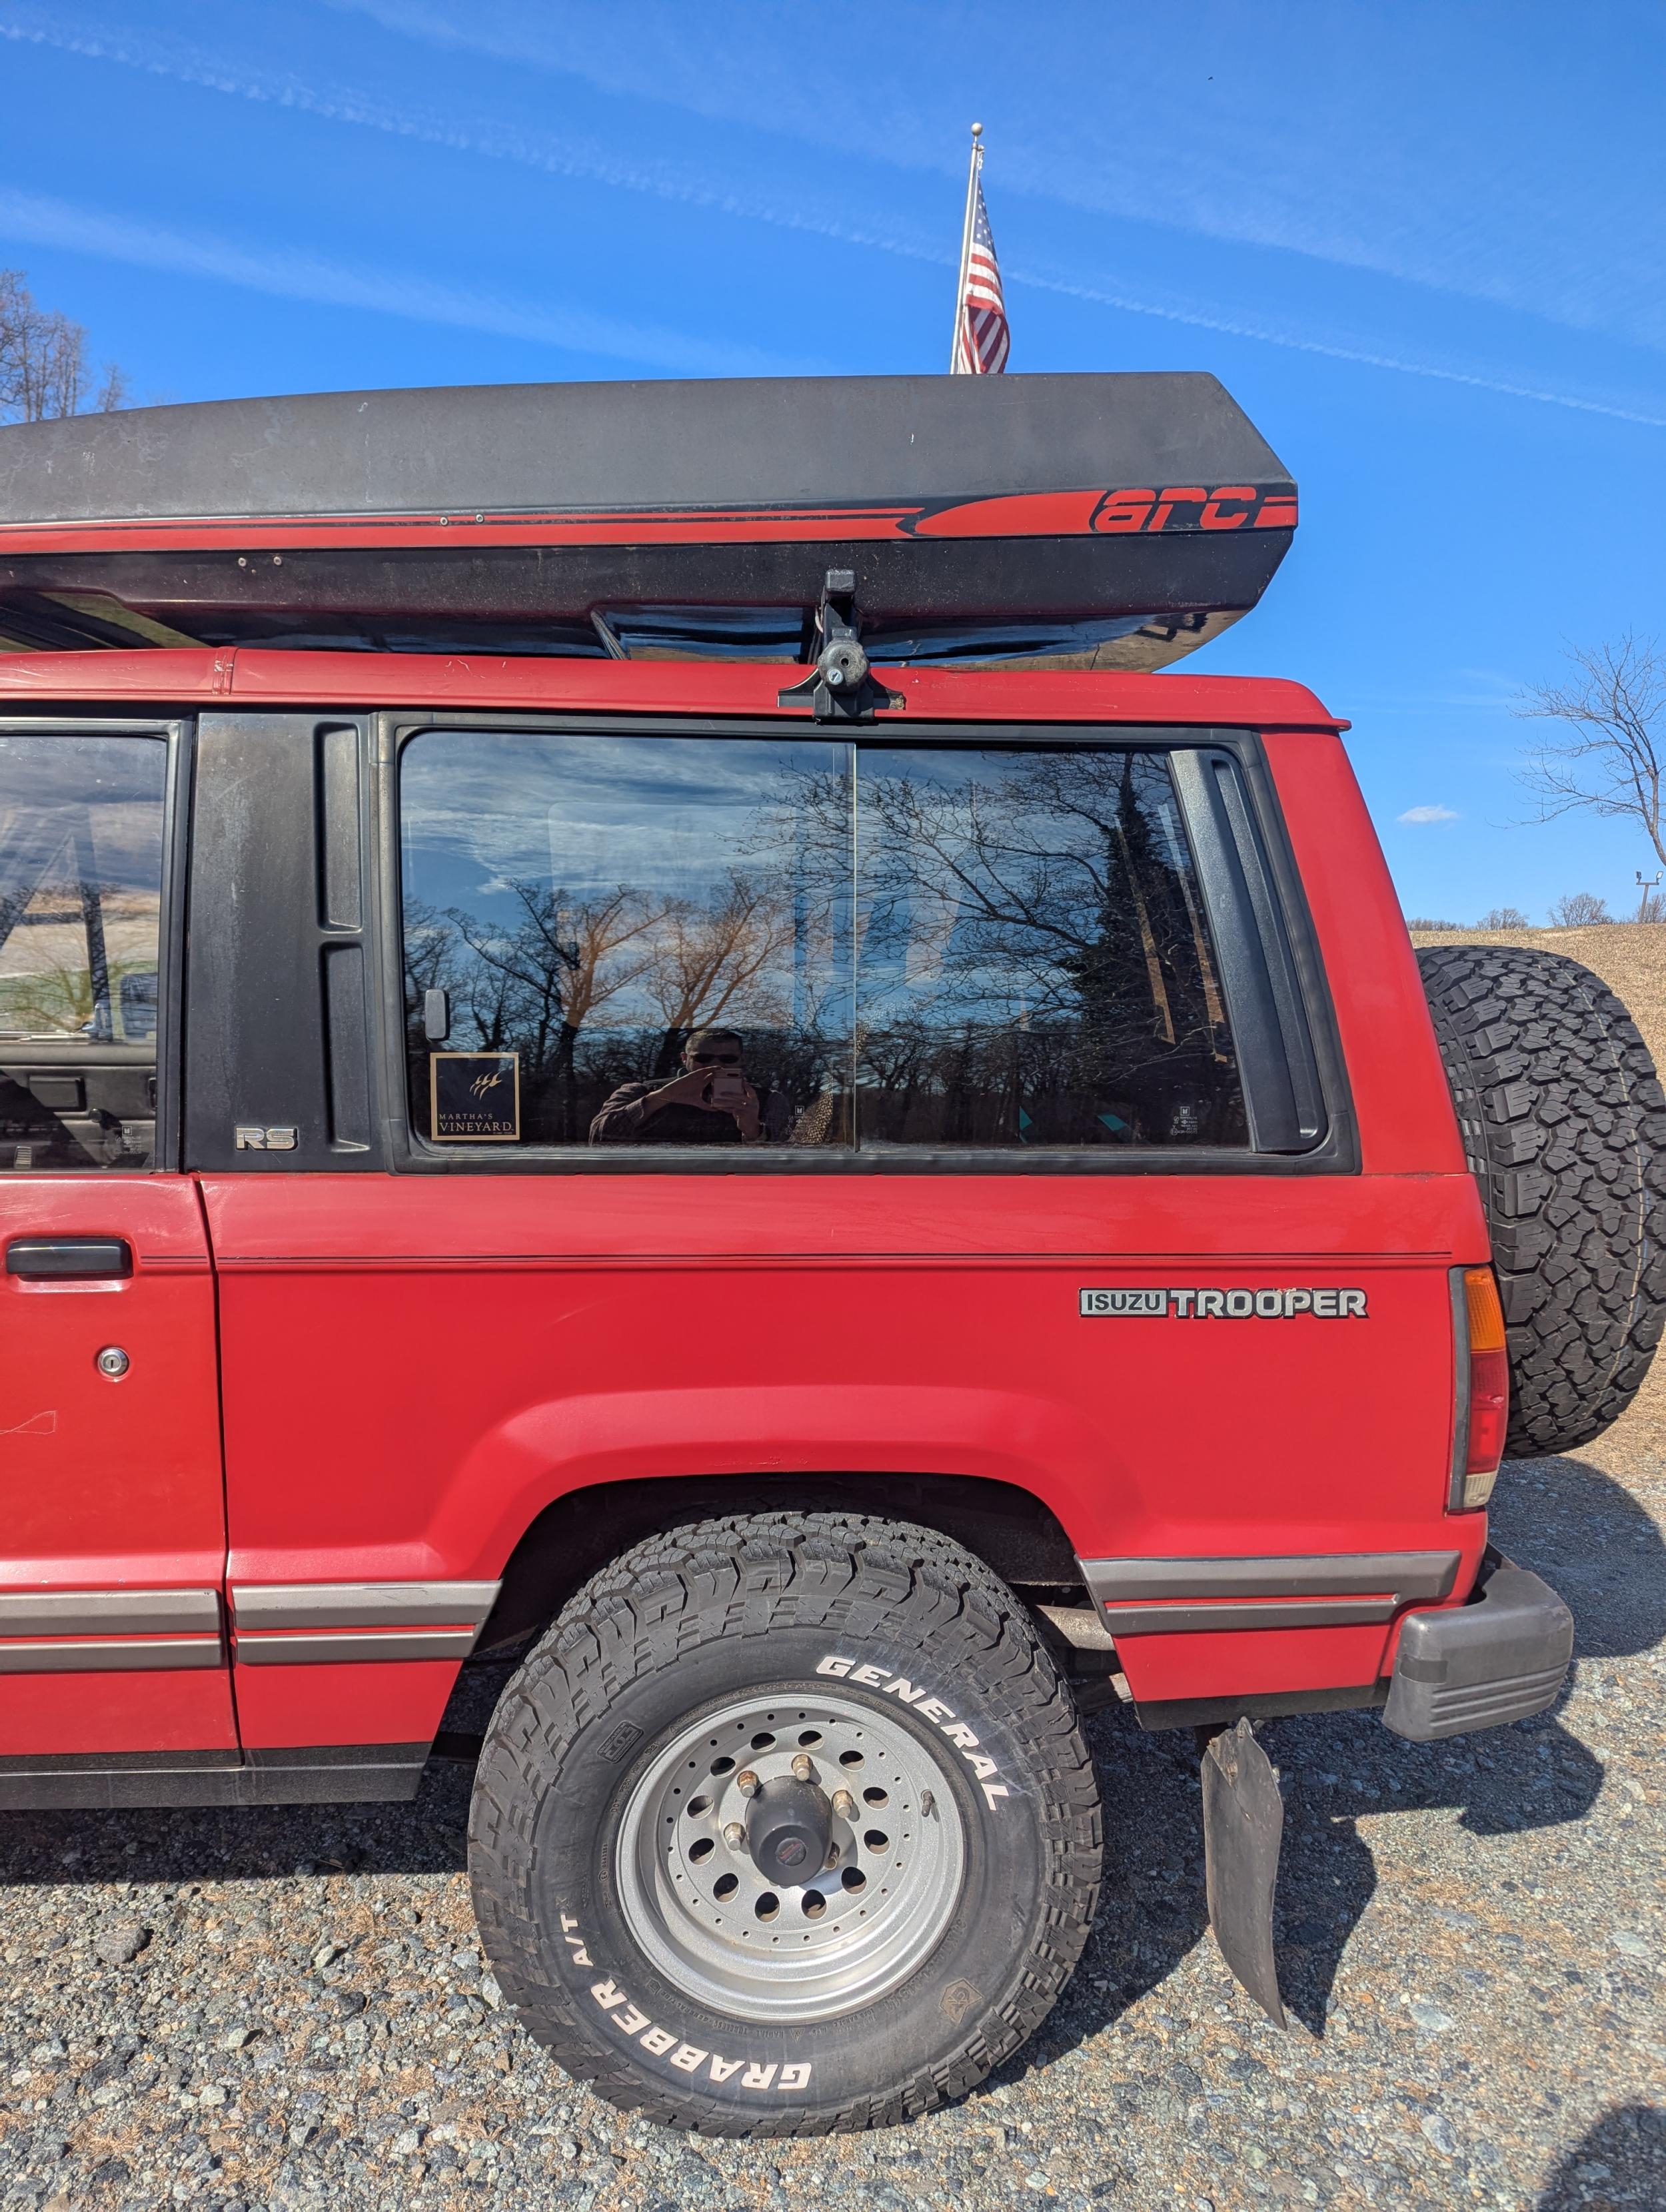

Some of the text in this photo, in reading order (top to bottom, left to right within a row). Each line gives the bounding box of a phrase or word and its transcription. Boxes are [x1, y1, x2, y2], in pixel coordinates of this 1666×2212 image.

[236, 1127, 296, 1150] RS
[439, 1122, 512, 1131] VINEYARD
[1087, 1288, 1368, 1318] ISUZU TROOPER
[816, 1656, 1010, 1812] GENERAL
[590, 1977, 812, 2090] GRABBER
